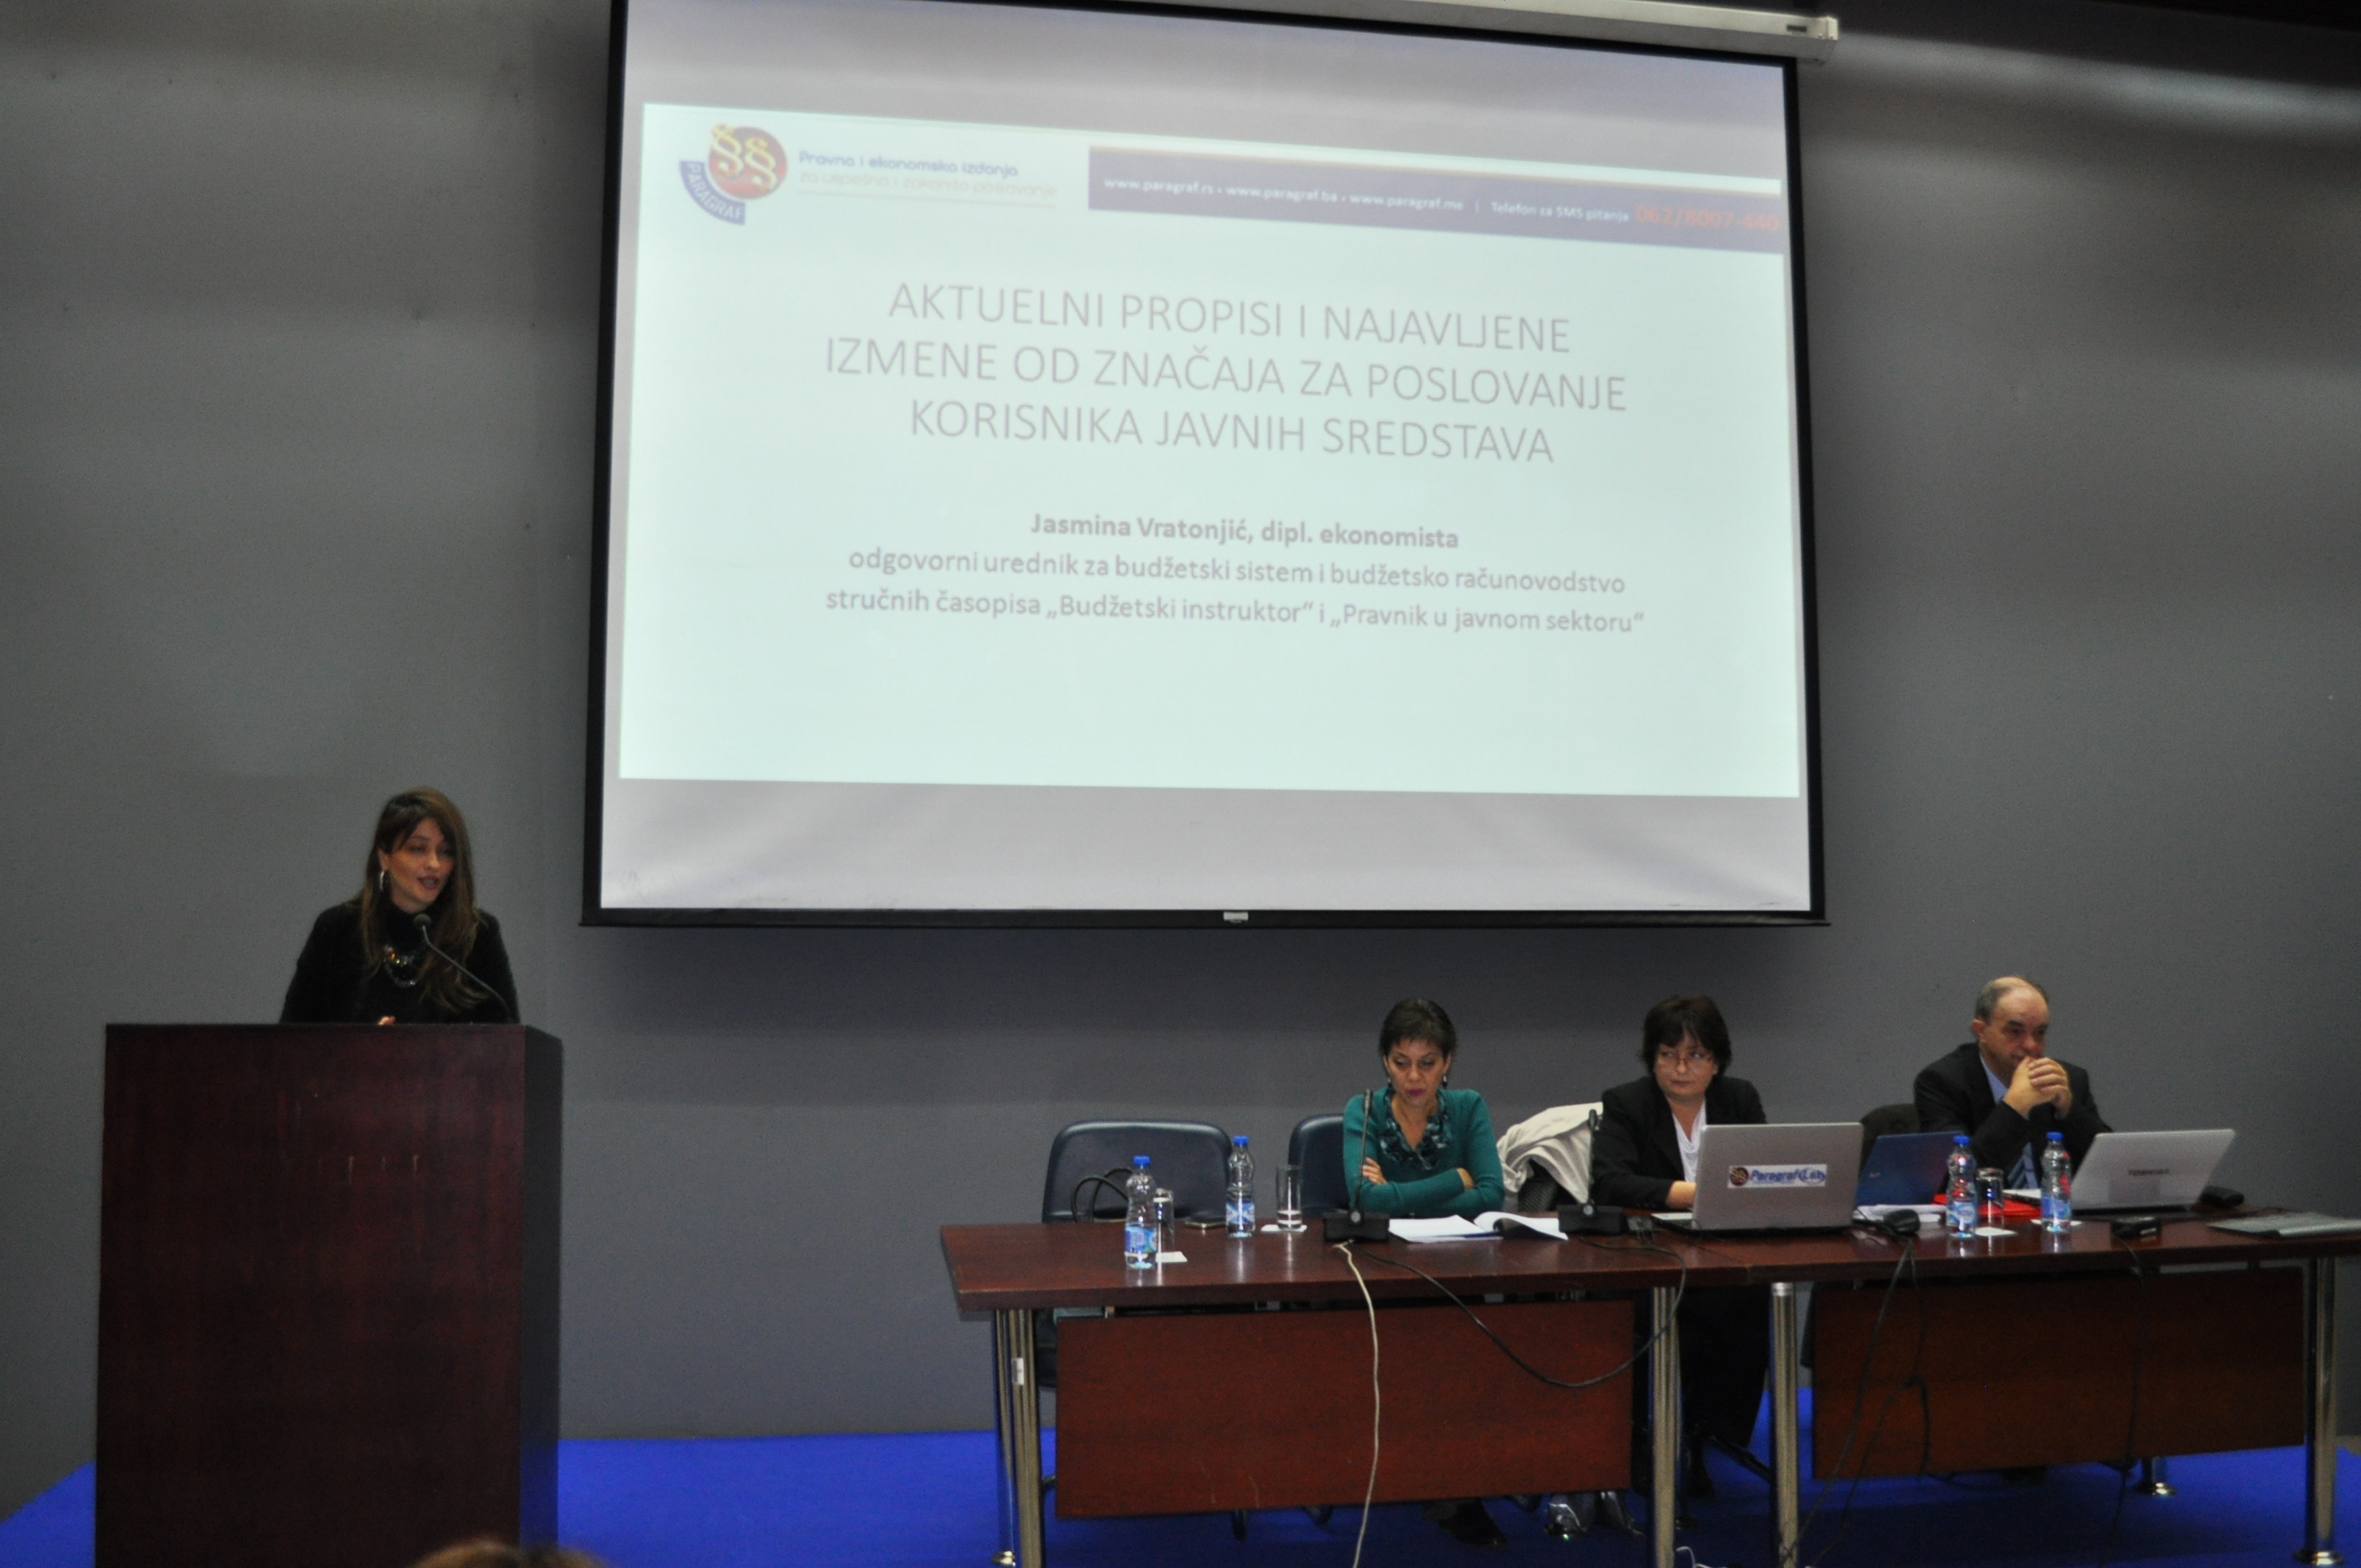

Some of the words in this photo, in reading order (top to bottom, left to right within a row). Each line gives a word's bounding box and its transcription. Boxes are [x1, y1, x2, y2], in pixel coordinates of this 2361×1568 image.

[798, 150, 855, 167] Pravna
[868, 155, 957, 173] ekonomska
[962, 161, 1018, 179] izdanja
[686, 161, 742, 219] PARAGRAF
[1104, 178, 1214, 195] www.paragraf.rs
[1226, 185, 1338, 203] www.paragraf.ba
[1349, 193, 1464, 211] www.paragraf.me
[1491, 201, 1536, 215] Telefon
[1556, 206, 1583, 219] SMS
[1586, 209, 1630, 223] pitanja
[888, 283, 1103, 328] AKTUELNI
[1122, 294, 1281, 338] PROPISI
[1300, 304, 1306, 338] I
[1324, 305, 1570, 353] NAJAVLJENE
[827, 336, 998, 380] IZMENE
[1014, 346, 1079, 384] OD
[1093, 344, 1285, 393] ZNAČAJA
[1299, 360, 1352, 397] ZA
[1368, 363, 1627, 412] POSLOVANJE
[912, 399, 1143, 444] KORISNIKA
[1155, 410, 1305, 452] JAVNIH
[1322, 417, 1554, 463] SREDSTAVA
[1031, 513, 1131, 537] Jasmina
[1136, 516, 1254, 546] Vratonjić,
[1261, 520, 1313, 548] dipl.
[1319, 523, 1459, 549] ekonomista
[849, 547, 978, 575] odgovorni
[983, 553, 1079, 576] urednik
[1084, 559, 1109, 576] za
[1114, 554, 1230, 581] budžetski
[1235, 560, 1313, 584] sistem
[1319, 562, 1324, 584] i
[1330, 562, 1449, 588] budžetsko
[1454, 567, 1626, 594] računovodstvo
[826, 588, 929, 611] stručnih
[935, 590, 1041, 619] časopisa
[1046, 594, 1177, 620] „Budžetski
[1319, 603, 1324, 623] i
[1330, 603, 1428, 629] „Pravnik
[1433, 612, 1447, 627] u
[1454, 608, 1540, 633] javnom
